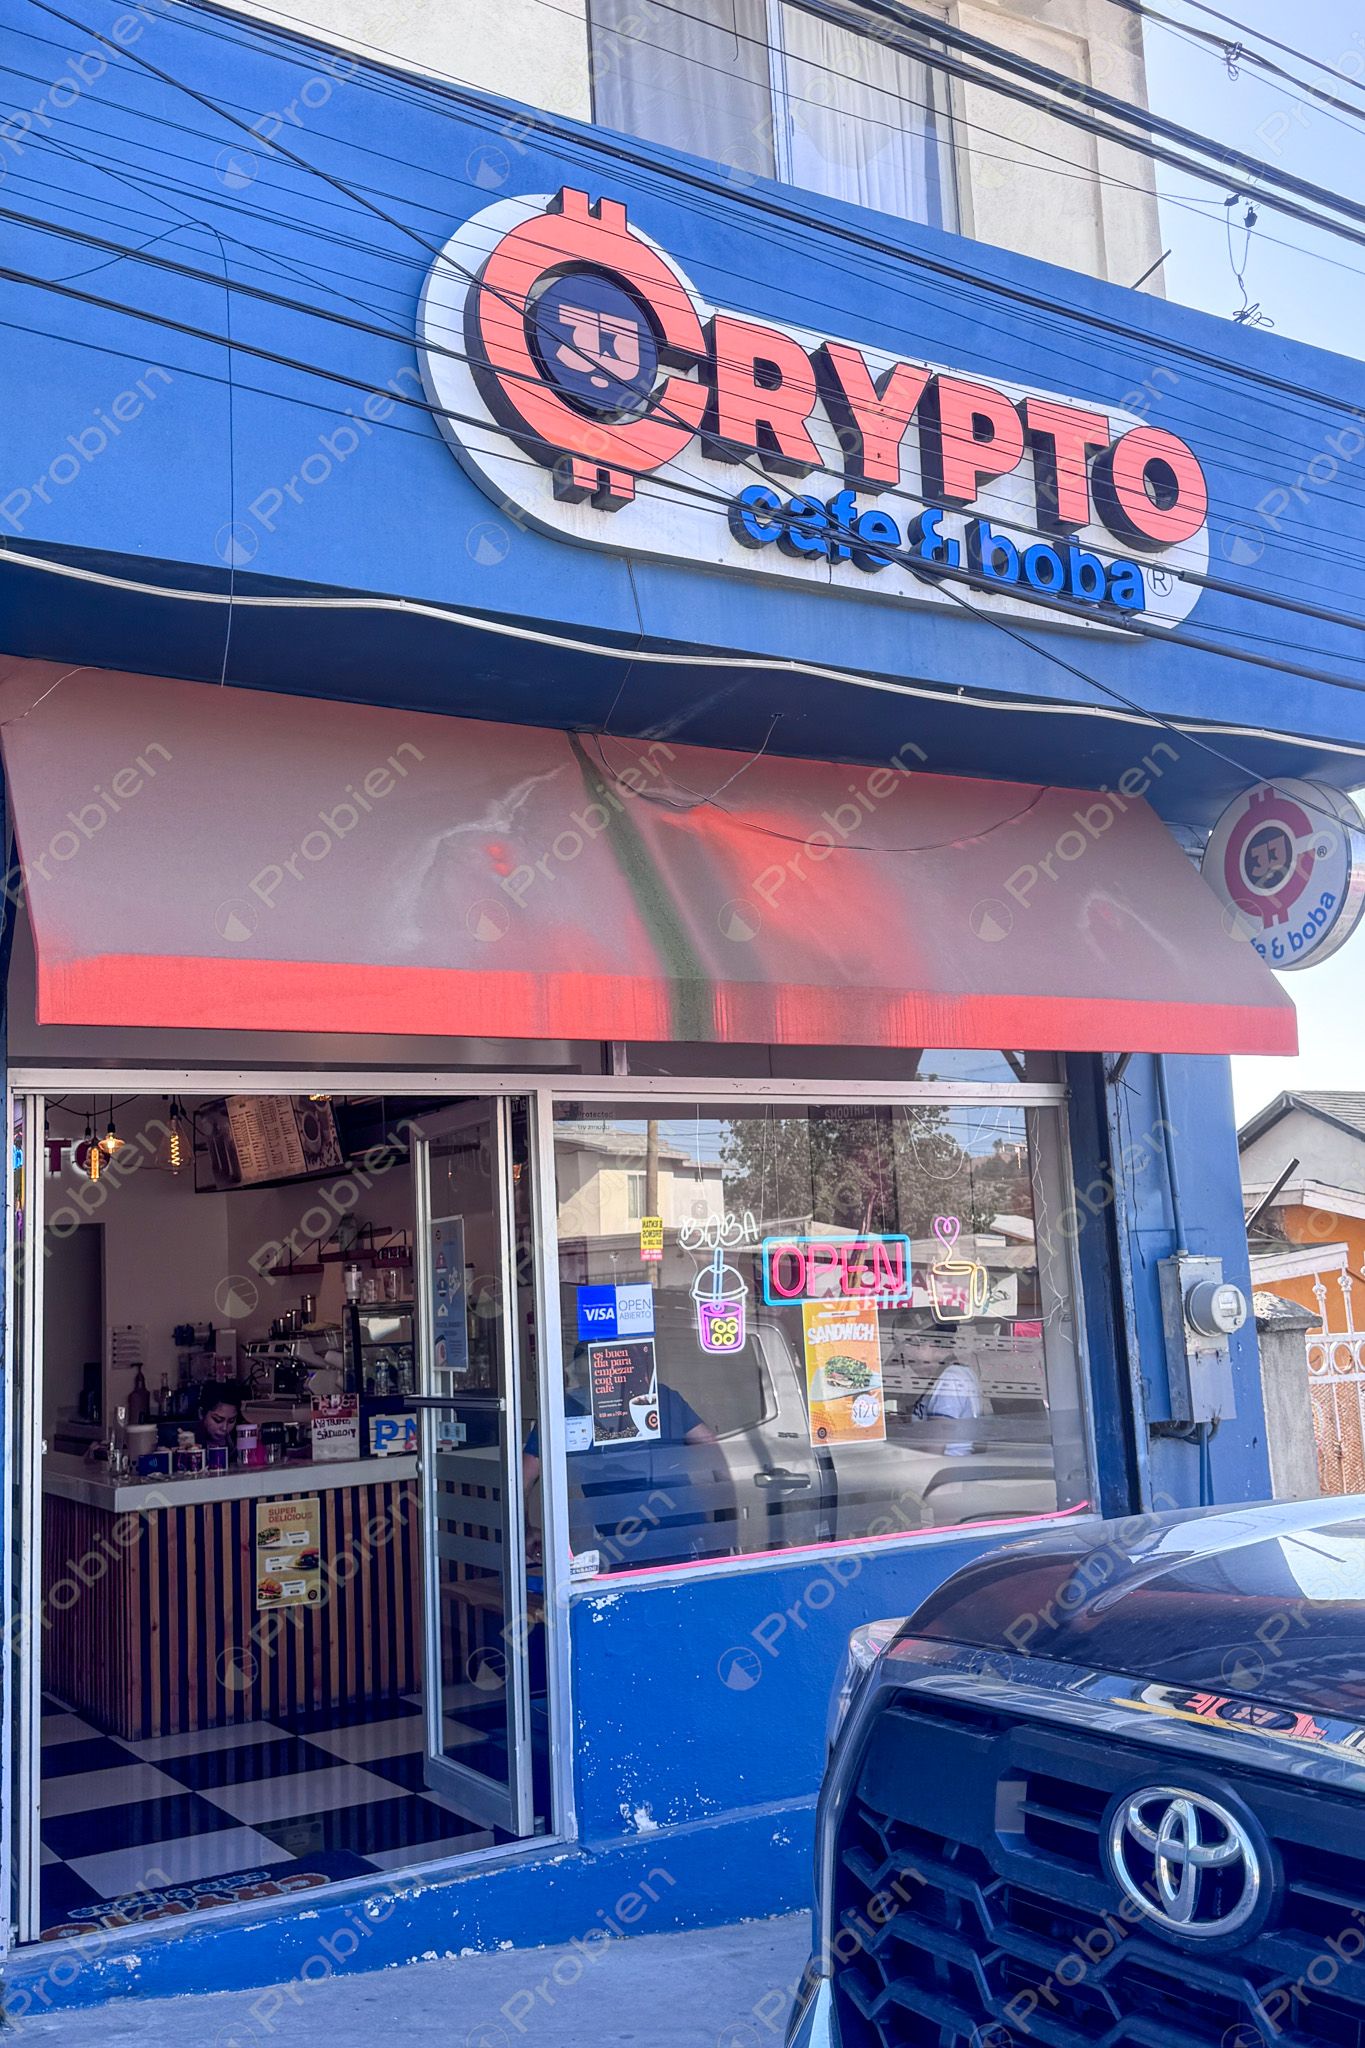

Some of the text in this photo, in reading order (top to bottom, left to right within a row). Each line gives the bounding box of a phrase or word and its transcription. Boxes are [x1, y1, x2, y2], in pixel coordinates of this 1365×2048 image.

[468, 186, 1208, 548] CRYPTO
[729, 485, 900, 572] cafe
[908, 509, 960, 578] &
[968, 518, 1146, 612] boba
[1287, 892, 1337, 952] boba
[824, 1105, 870, 1119] SMOOTHIE
[679, 1211, 760, 1251] BOBA
[772, 1242, 902, 1297] OPEN
[618, 1299, 651, 1312] OPEN
[583, 1307, 615, 1321] VISA
[619, 1311, 651, 1320] ABIERTO
[807, 1322, 875, 1345] SANDWICH
[593, 1348, 629, 1360] es buen
[610, 1358, 632, 1369] para
[594, 1366, 635, 1378] empezar
[614, 1376, 627, 1384] un
[268, 1507, 296, 1516] SUPER
[268, 1511, 313, 1523] DELICIOUS
